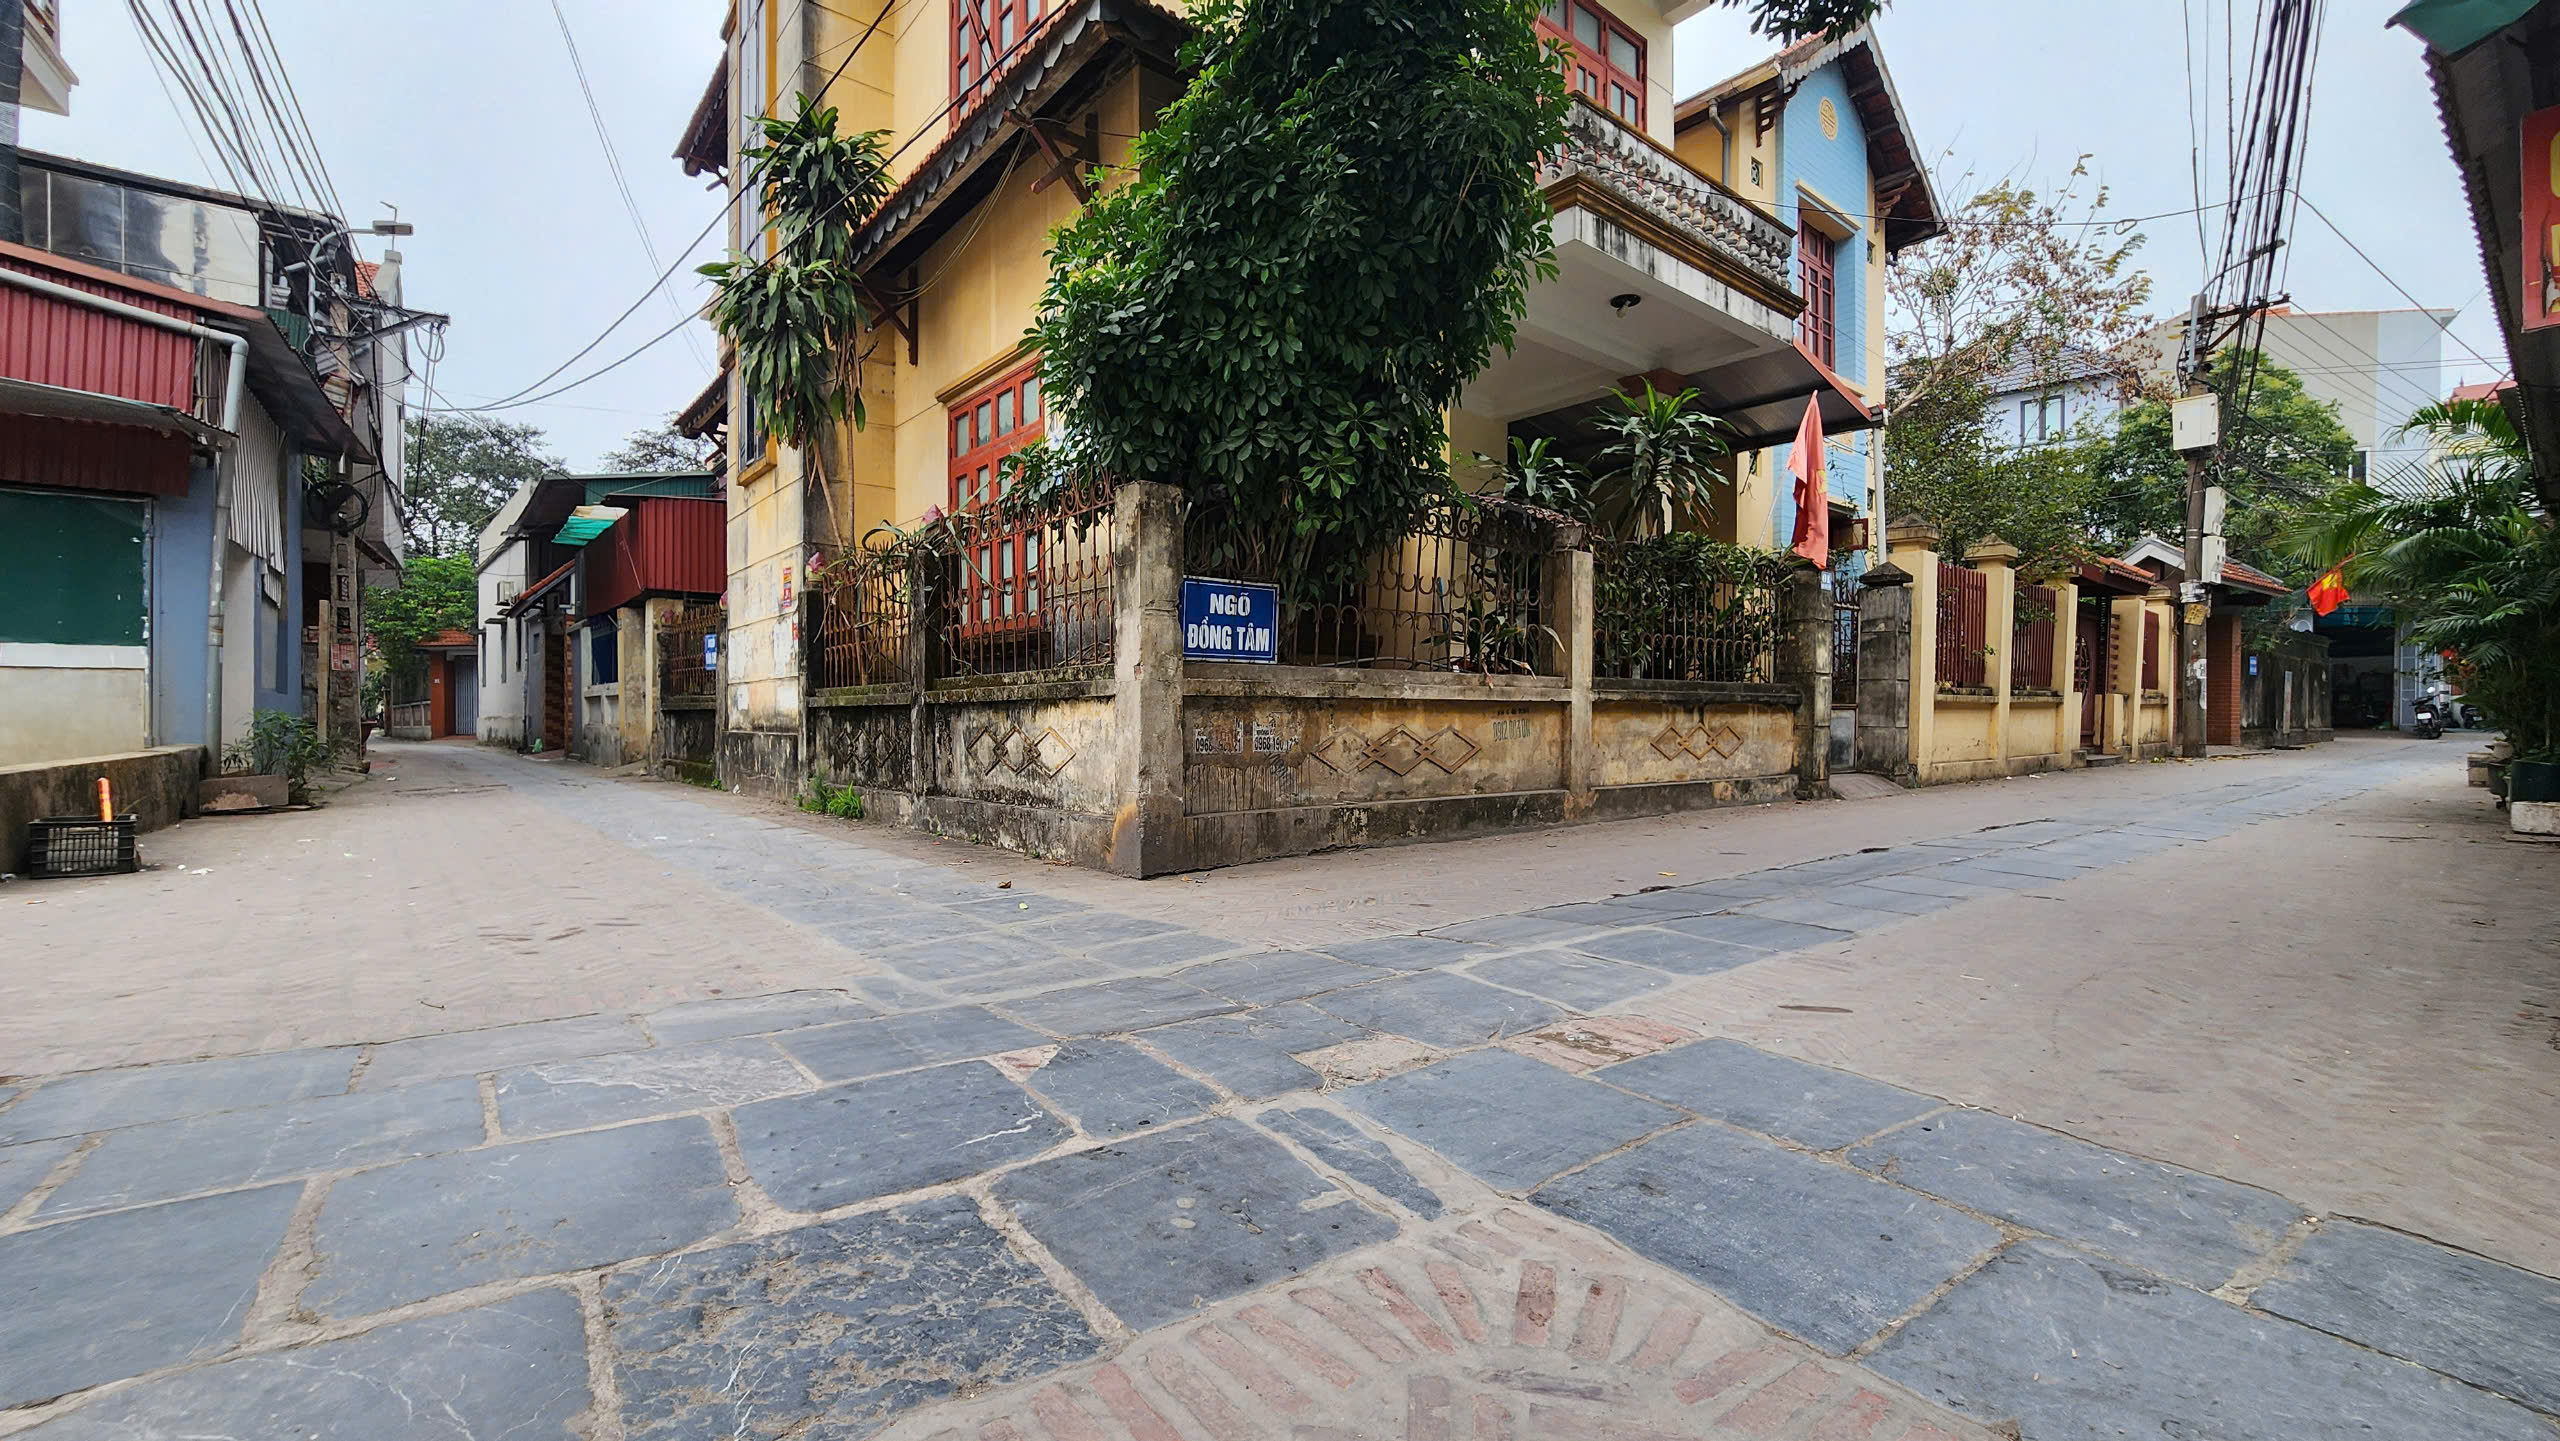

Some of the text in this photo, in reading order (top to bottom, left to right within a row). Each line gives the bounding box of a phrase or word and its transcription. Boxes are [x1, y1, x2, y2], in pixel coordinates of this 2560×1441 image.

[1209, 592, 1251, 617] NGÕ
[1187, 616, 1270, 652] ĐỒNG TÂM
